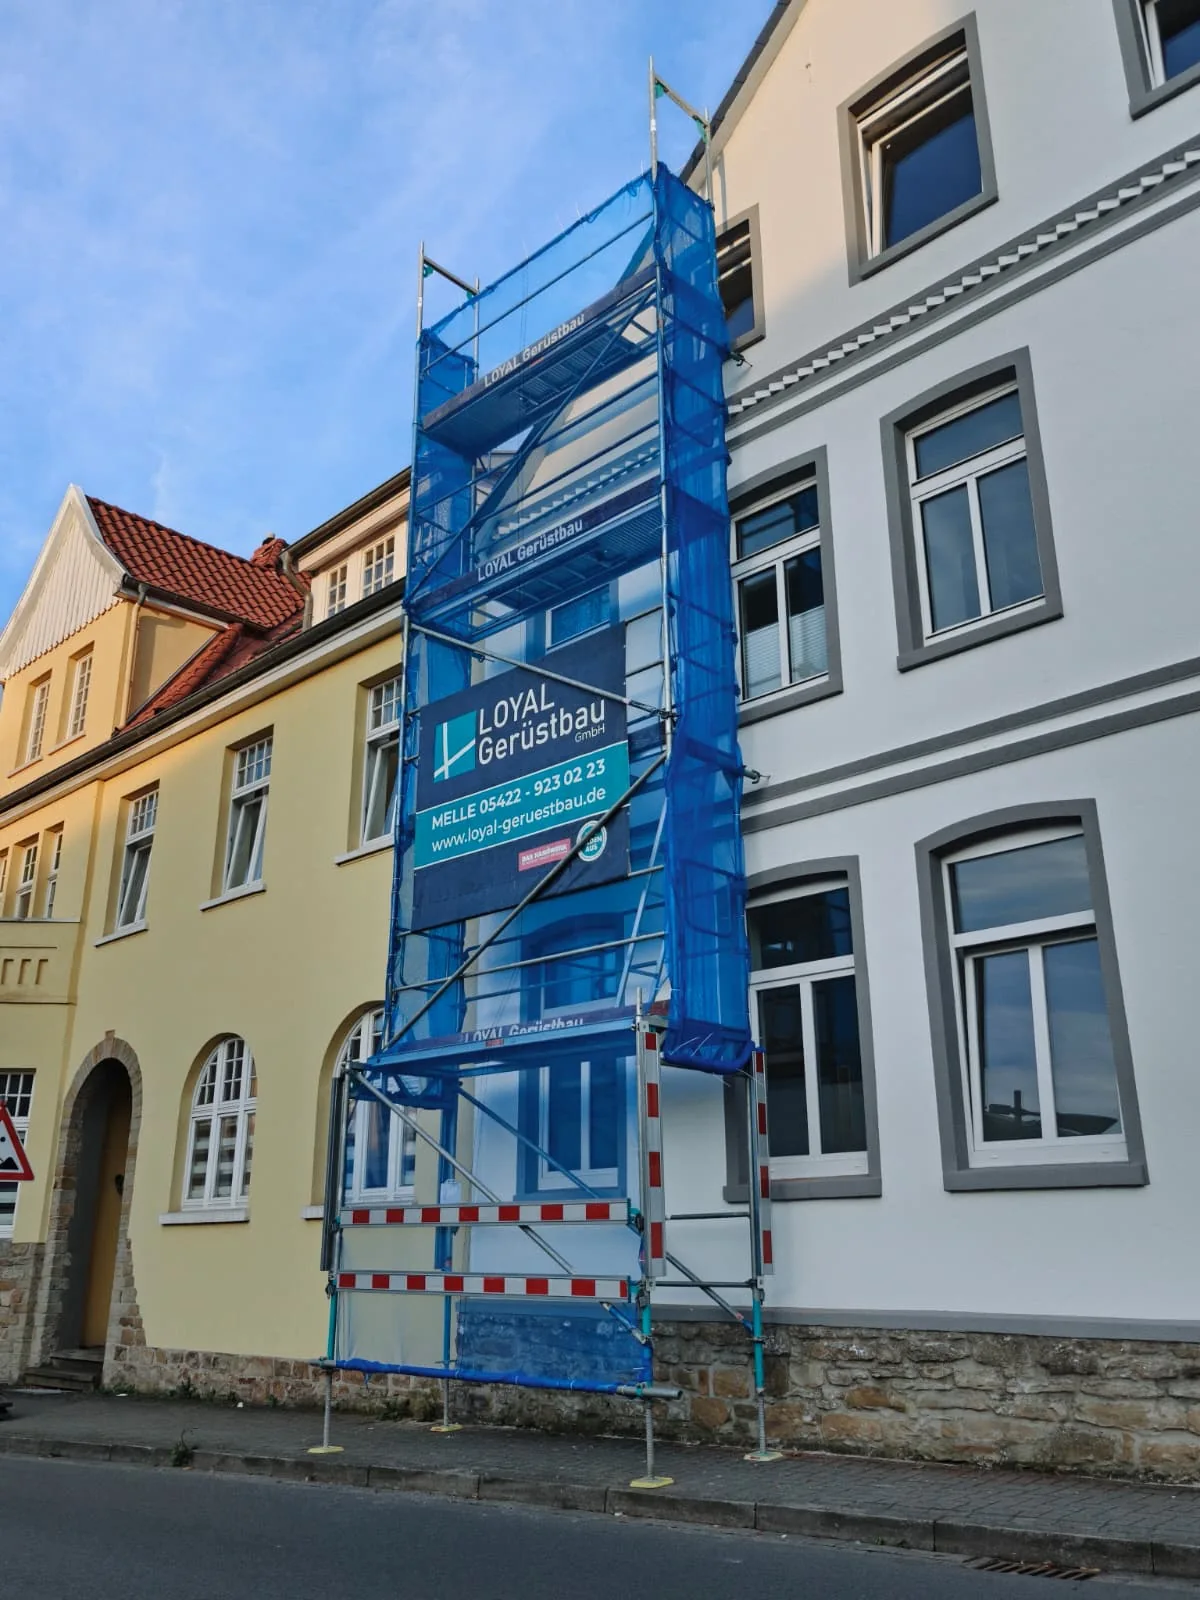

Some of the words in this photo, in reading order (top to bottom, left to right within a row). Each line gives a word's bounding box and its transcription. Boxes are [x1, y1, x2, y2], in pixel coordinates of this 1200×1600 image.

[484, 355, 520, 387] LOYAL
[522, 314, 585, 360] Gerüstbau
[477, 555, 516, 581] LOYAL
[517, 518, 583, 561] Gerüstbau
[478, 700, 605, 765] Gerüstbau
[480, 683, 555, 735] LOYAL
[575, 725, 605, 743] GmbH
[431, 803, 477, 831] MELLE
[480, 788, 522, 815] 05422
[534, 778, 561, 797] 923
[564, 767, 582, 786] 02
[587, 758, 606, 778] 23
[432, 788, 606, 852] www.loyal-geruestbau.de
